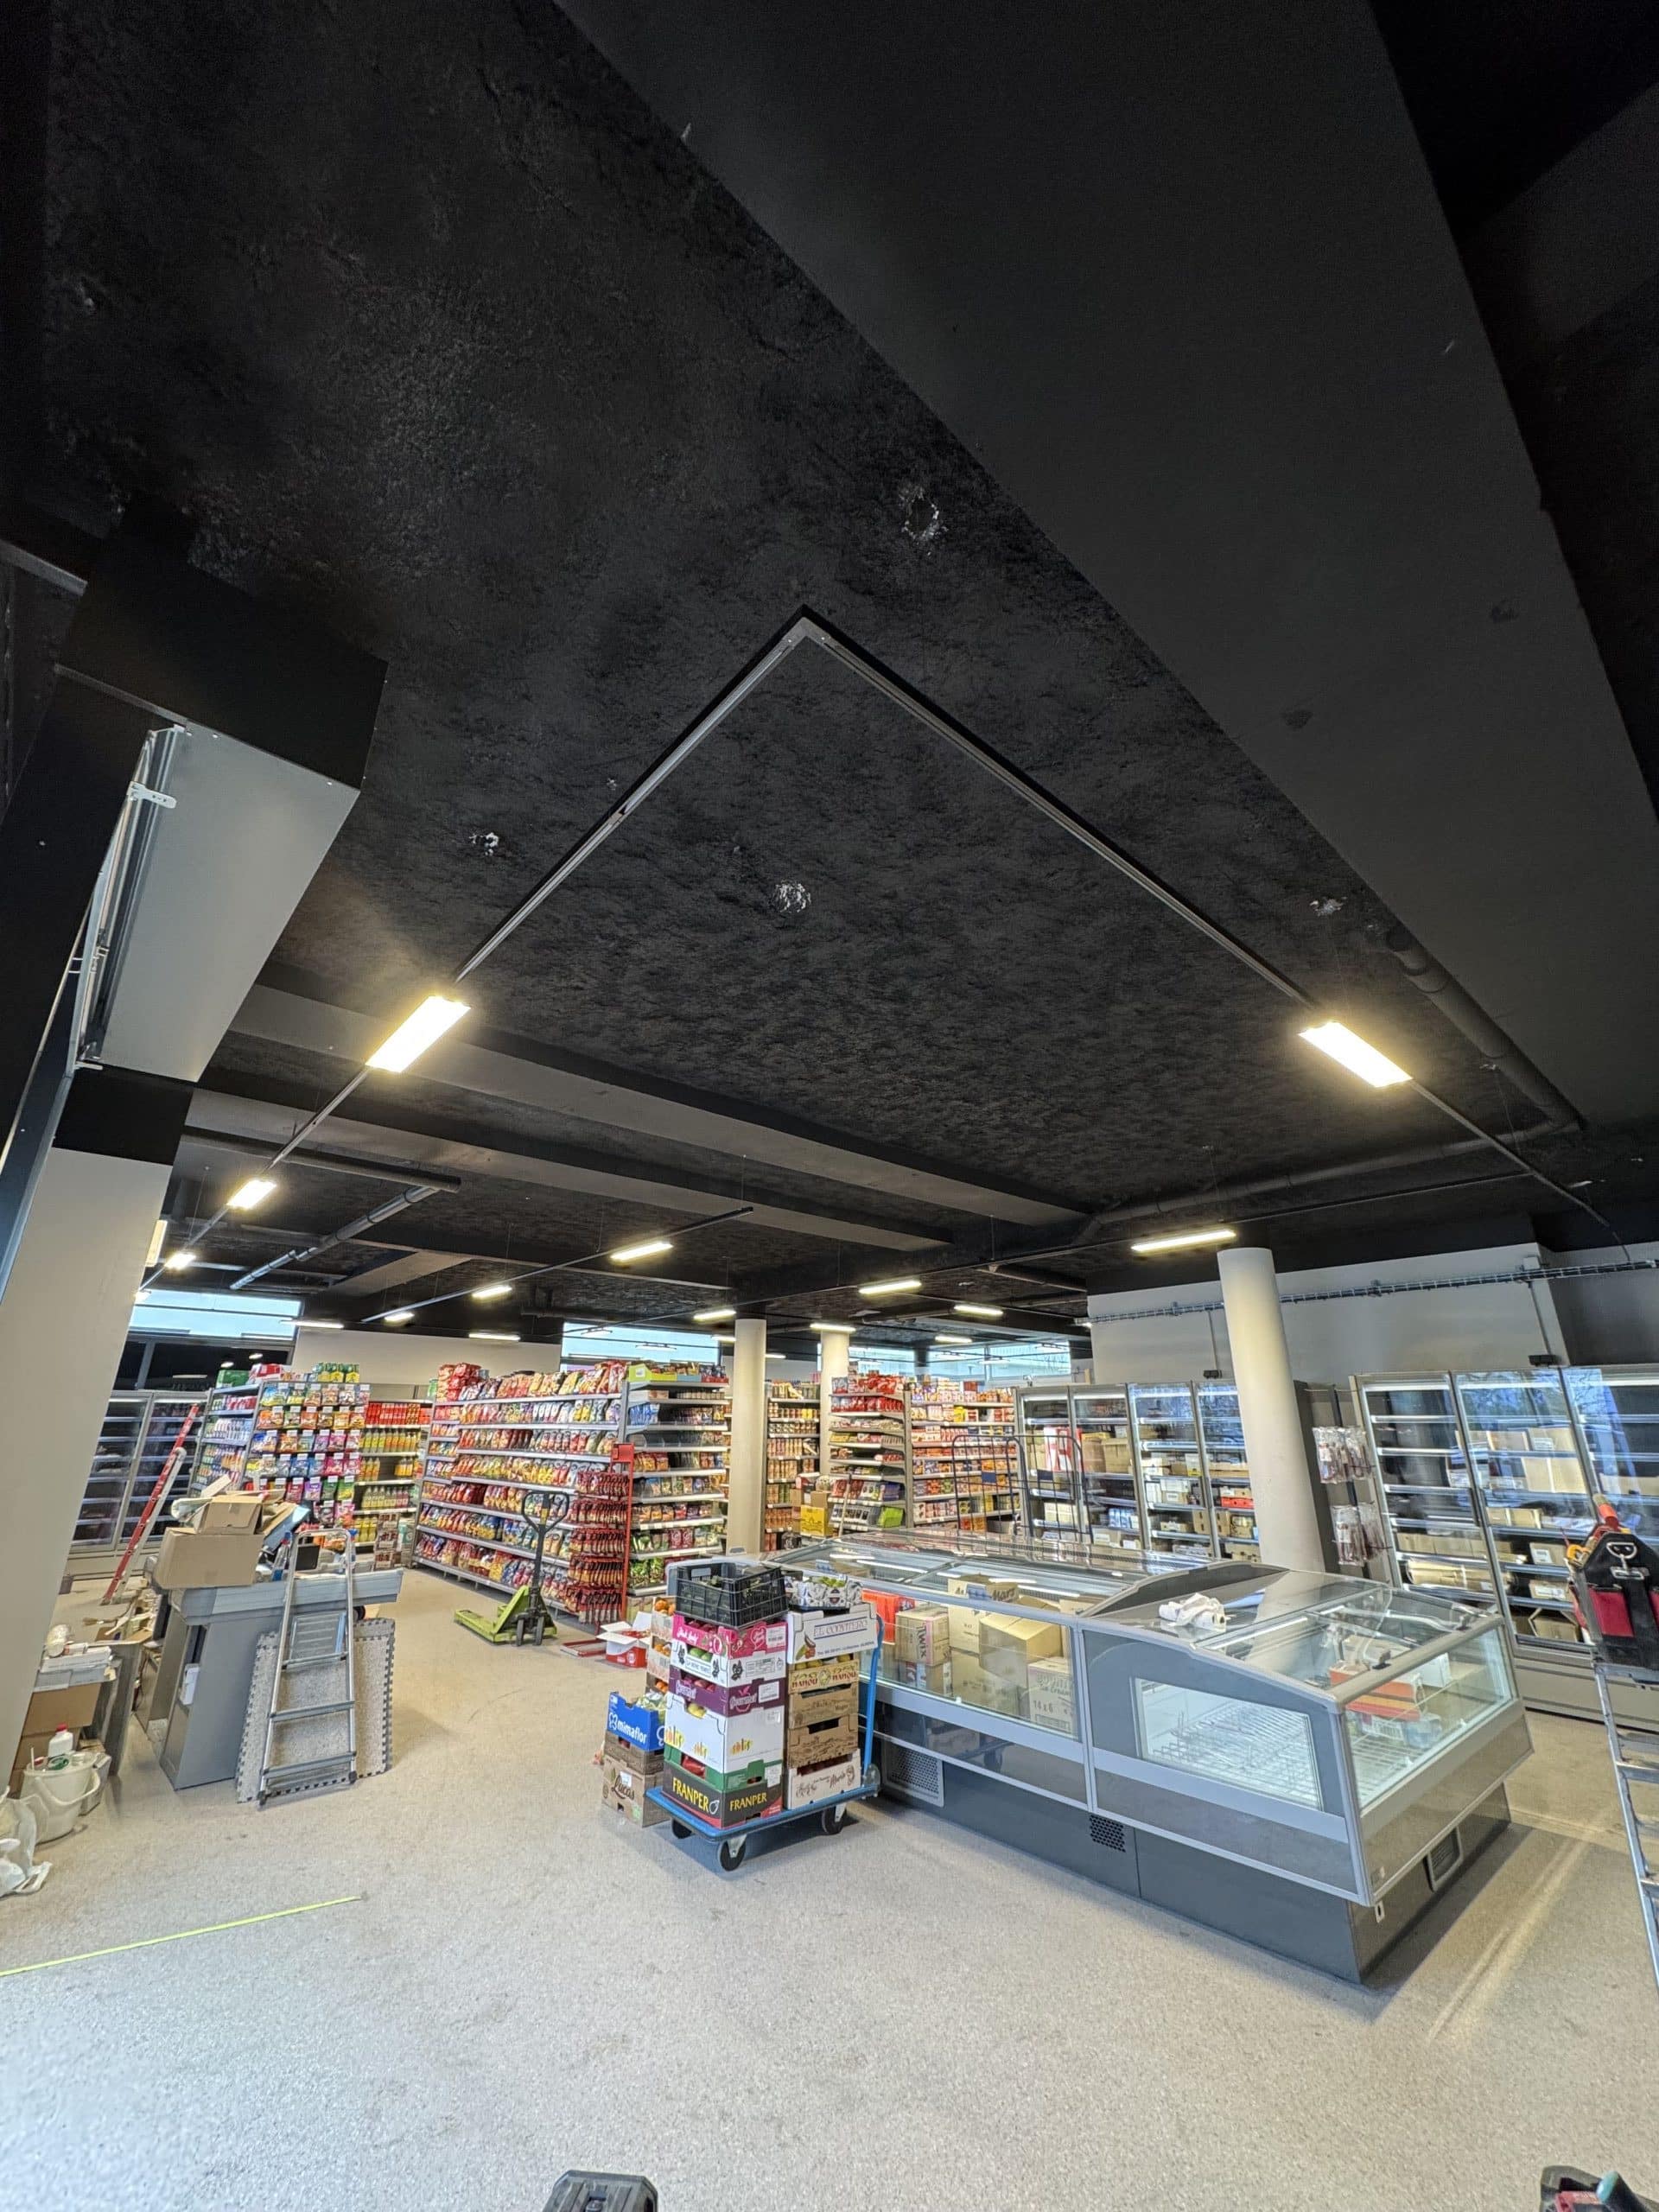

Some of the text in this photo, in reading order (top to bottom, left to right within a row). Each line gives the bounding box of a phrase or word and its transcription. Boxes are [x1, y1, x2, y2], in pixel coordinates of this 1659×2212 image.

[617, 1719, 647, 1745] mimaflor
[672, 1777, 709, 1813] FRANPER
[729, 1792, 767, 1812] FRANPER
